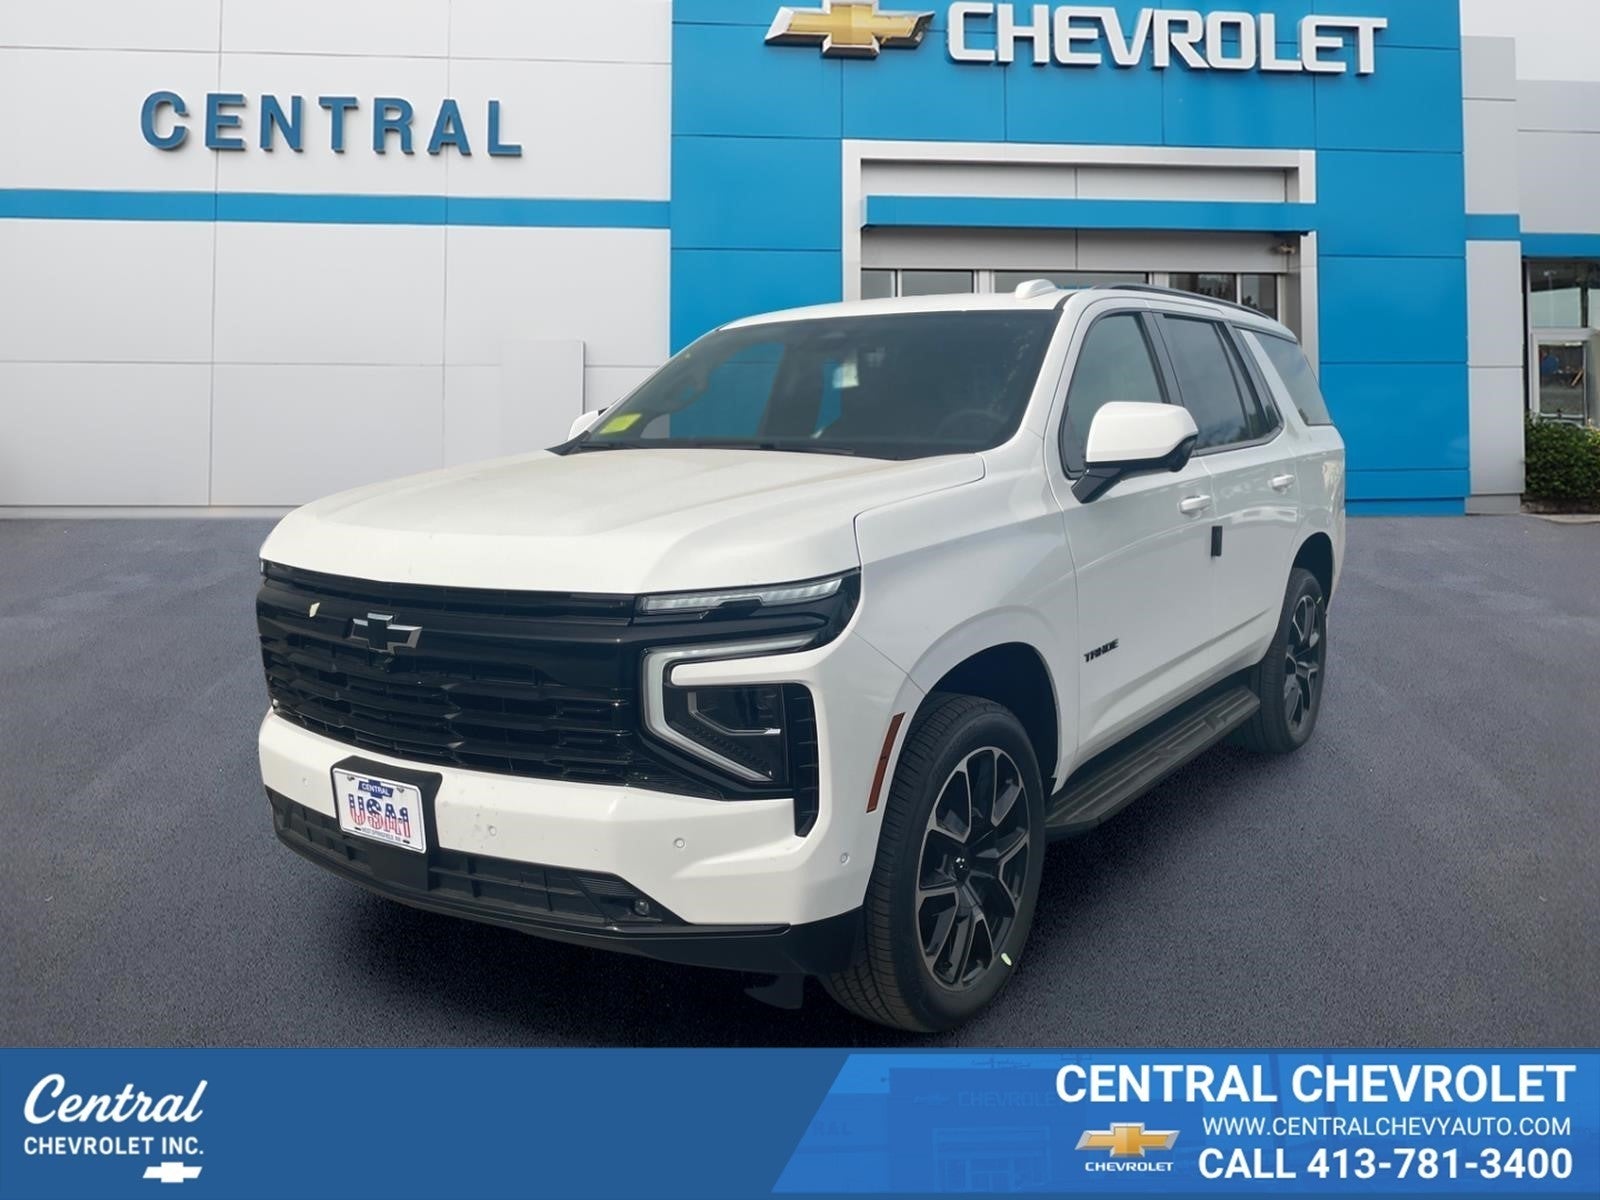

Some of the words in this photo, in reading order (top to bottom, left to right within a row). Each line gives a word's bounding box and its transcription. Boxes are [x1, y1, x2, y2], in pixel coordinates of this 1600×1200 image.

[947, 1, 1388, 76] CHEVROLET
[140, 90, 522, 158] CENTRAL
[361, 783, 391, 796] CENTRAL
